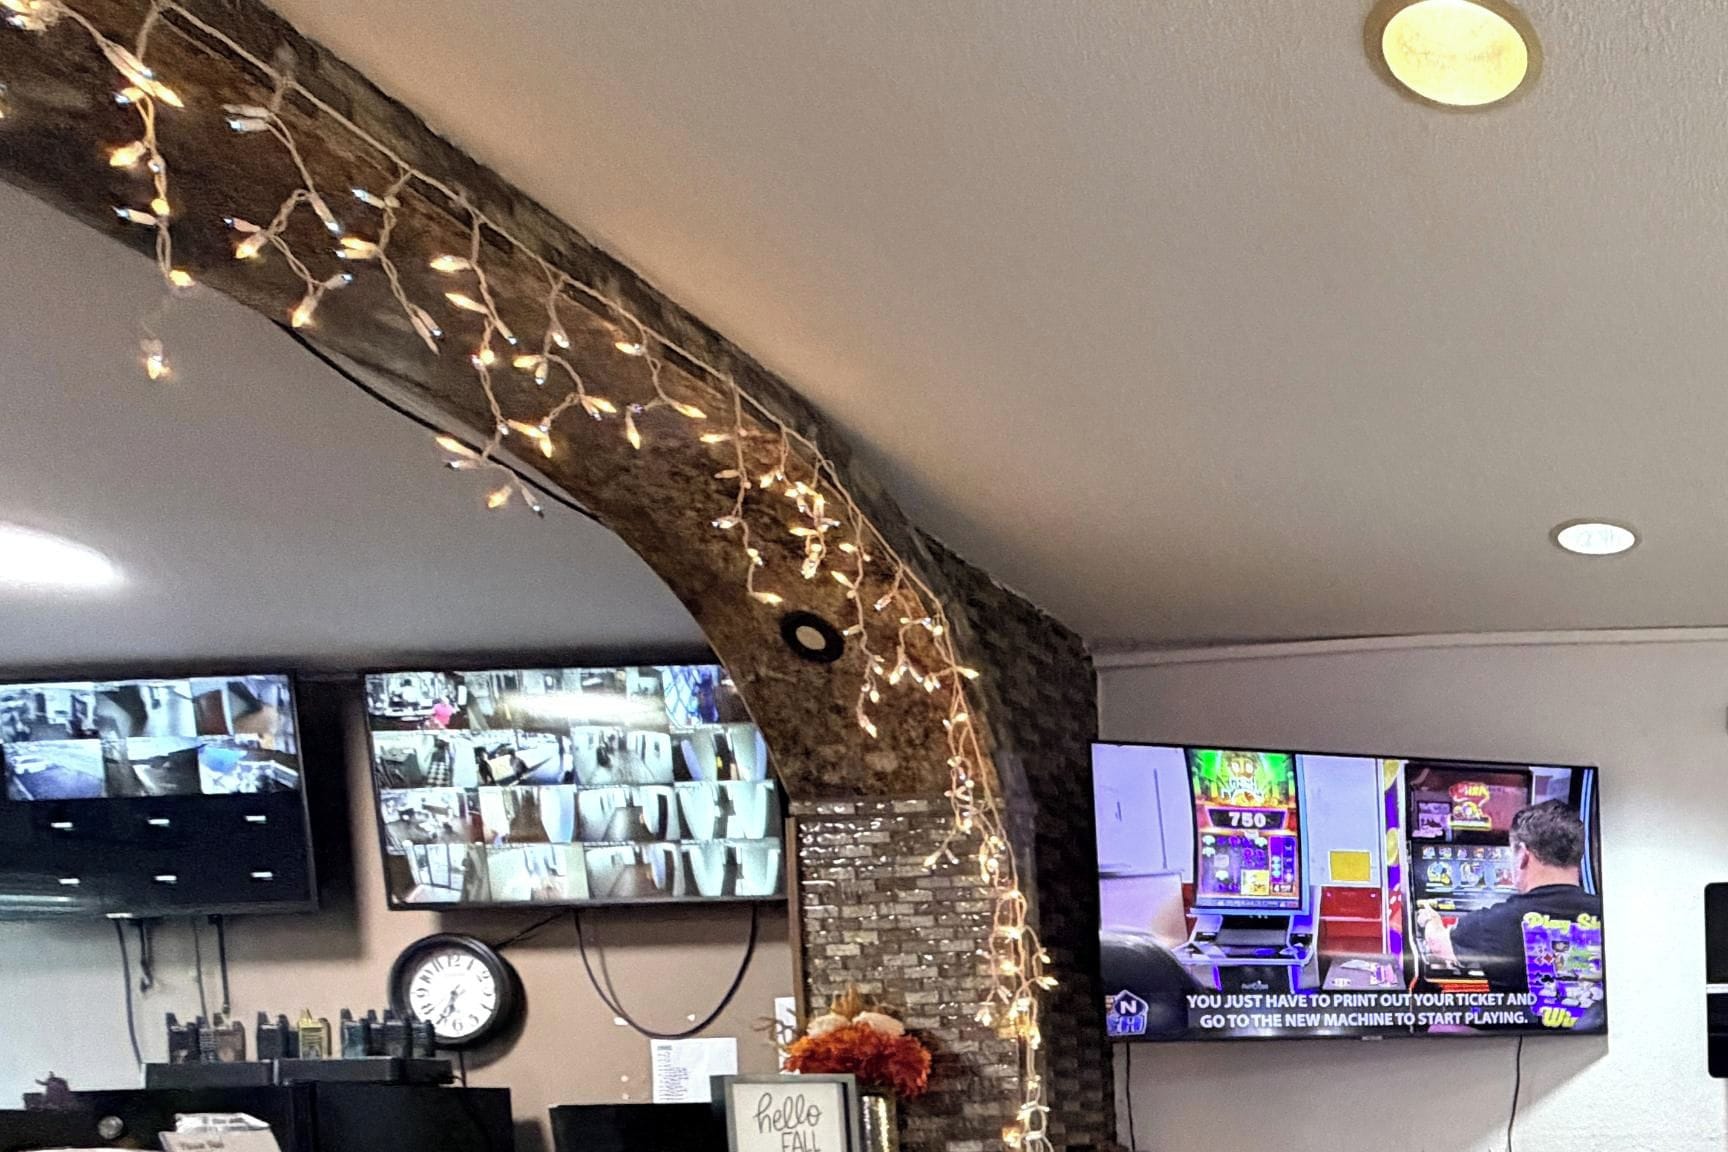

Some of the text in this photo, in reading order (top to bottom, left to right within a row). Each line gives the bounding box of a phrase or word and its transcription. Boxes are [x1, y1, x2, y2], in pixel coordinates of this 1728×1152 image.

[1228, 811, 1266, 828] 750
[1186, 992, 1538, 1009] YOU JUST HAVE TO PRINT OUT YOUR TICKET AND
[1200, 1010, 1529, 1028] GO TO THE NEW MACHINE TO START PLAYING.
[753, 1092, 823, 1134] hello
